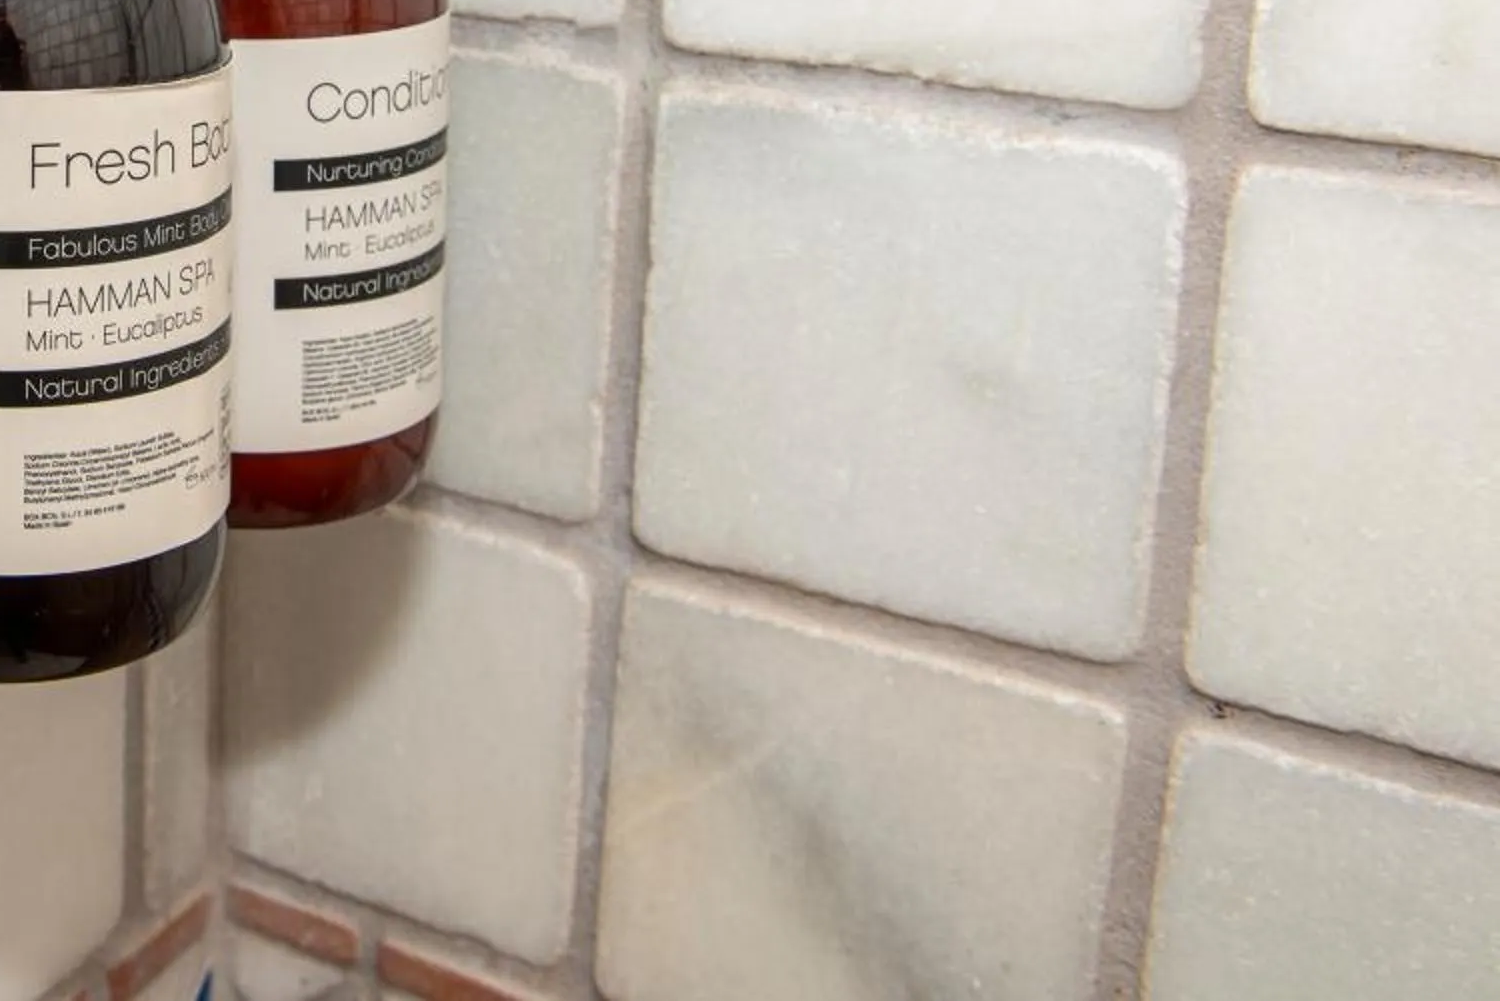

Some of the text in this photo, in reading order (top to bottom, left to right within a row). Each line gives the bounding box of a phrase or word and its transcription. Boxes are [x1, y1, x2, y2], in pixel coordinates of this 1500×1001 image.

[307, 62, 449, 124] Conditio
[31, 128, 176, 189] Fresh
[306, 156, 402, 184] Nurturing
[305, 191, 417, 233] HAMMAN
[29, 231, 138, 260] Fabulous
[143, 224, 187, 249] Mint
[305, 241, 351, 261] Mint
[26, 257, 215, 318] HAMMAN SPA
[303, 275, 381, 303] Natural
[26, 304, 204, 353] Mint Eucaliptus
[25, 369, 124, 400] Natural
